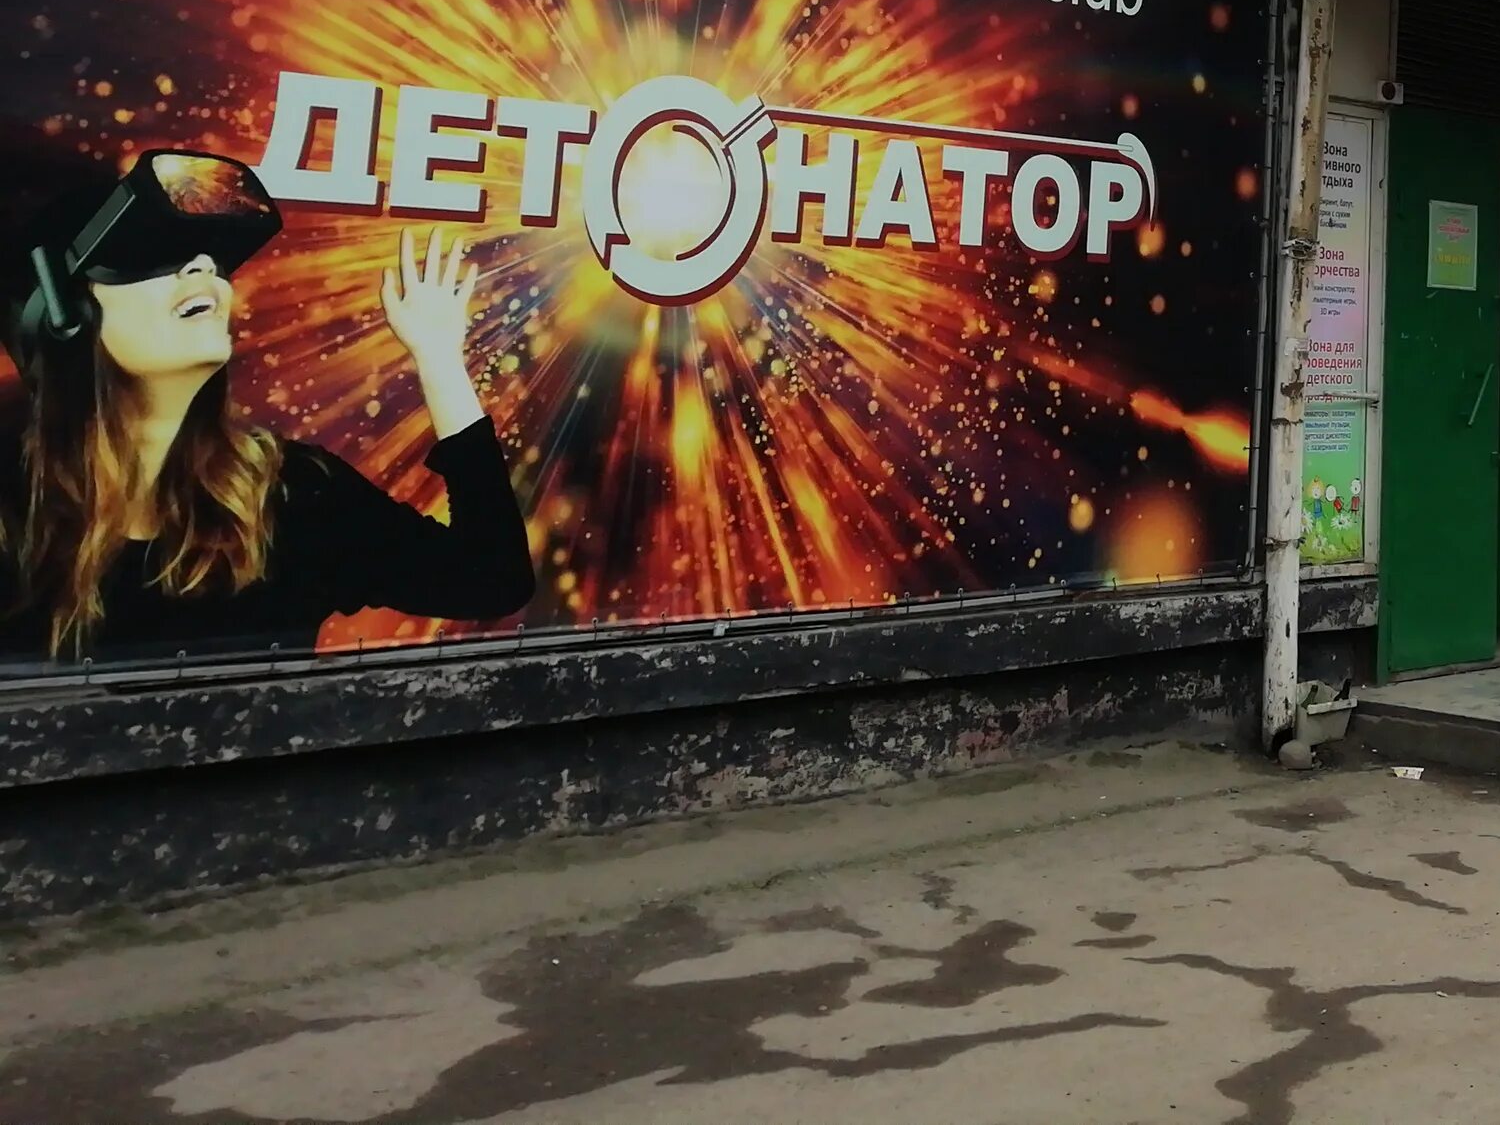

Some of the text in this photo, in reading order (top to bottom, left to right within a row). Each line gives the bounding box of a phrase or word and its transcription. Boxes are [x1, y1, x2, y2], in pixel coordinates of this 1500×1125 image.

[1323, 141, 1348, 157] Зона
[258, 70, 1157, 306] ДЕТОНАТОР
[1322, 175, 1354, 189] тдыха
[1319, 246, 1345, 261] Зона
[1315, 265, 1360, 278] орчества
[1335, 342, 1354, 355] для
[1307, 358, 1362, 371] оведения
[1306, 374, 1353, 387] детского
